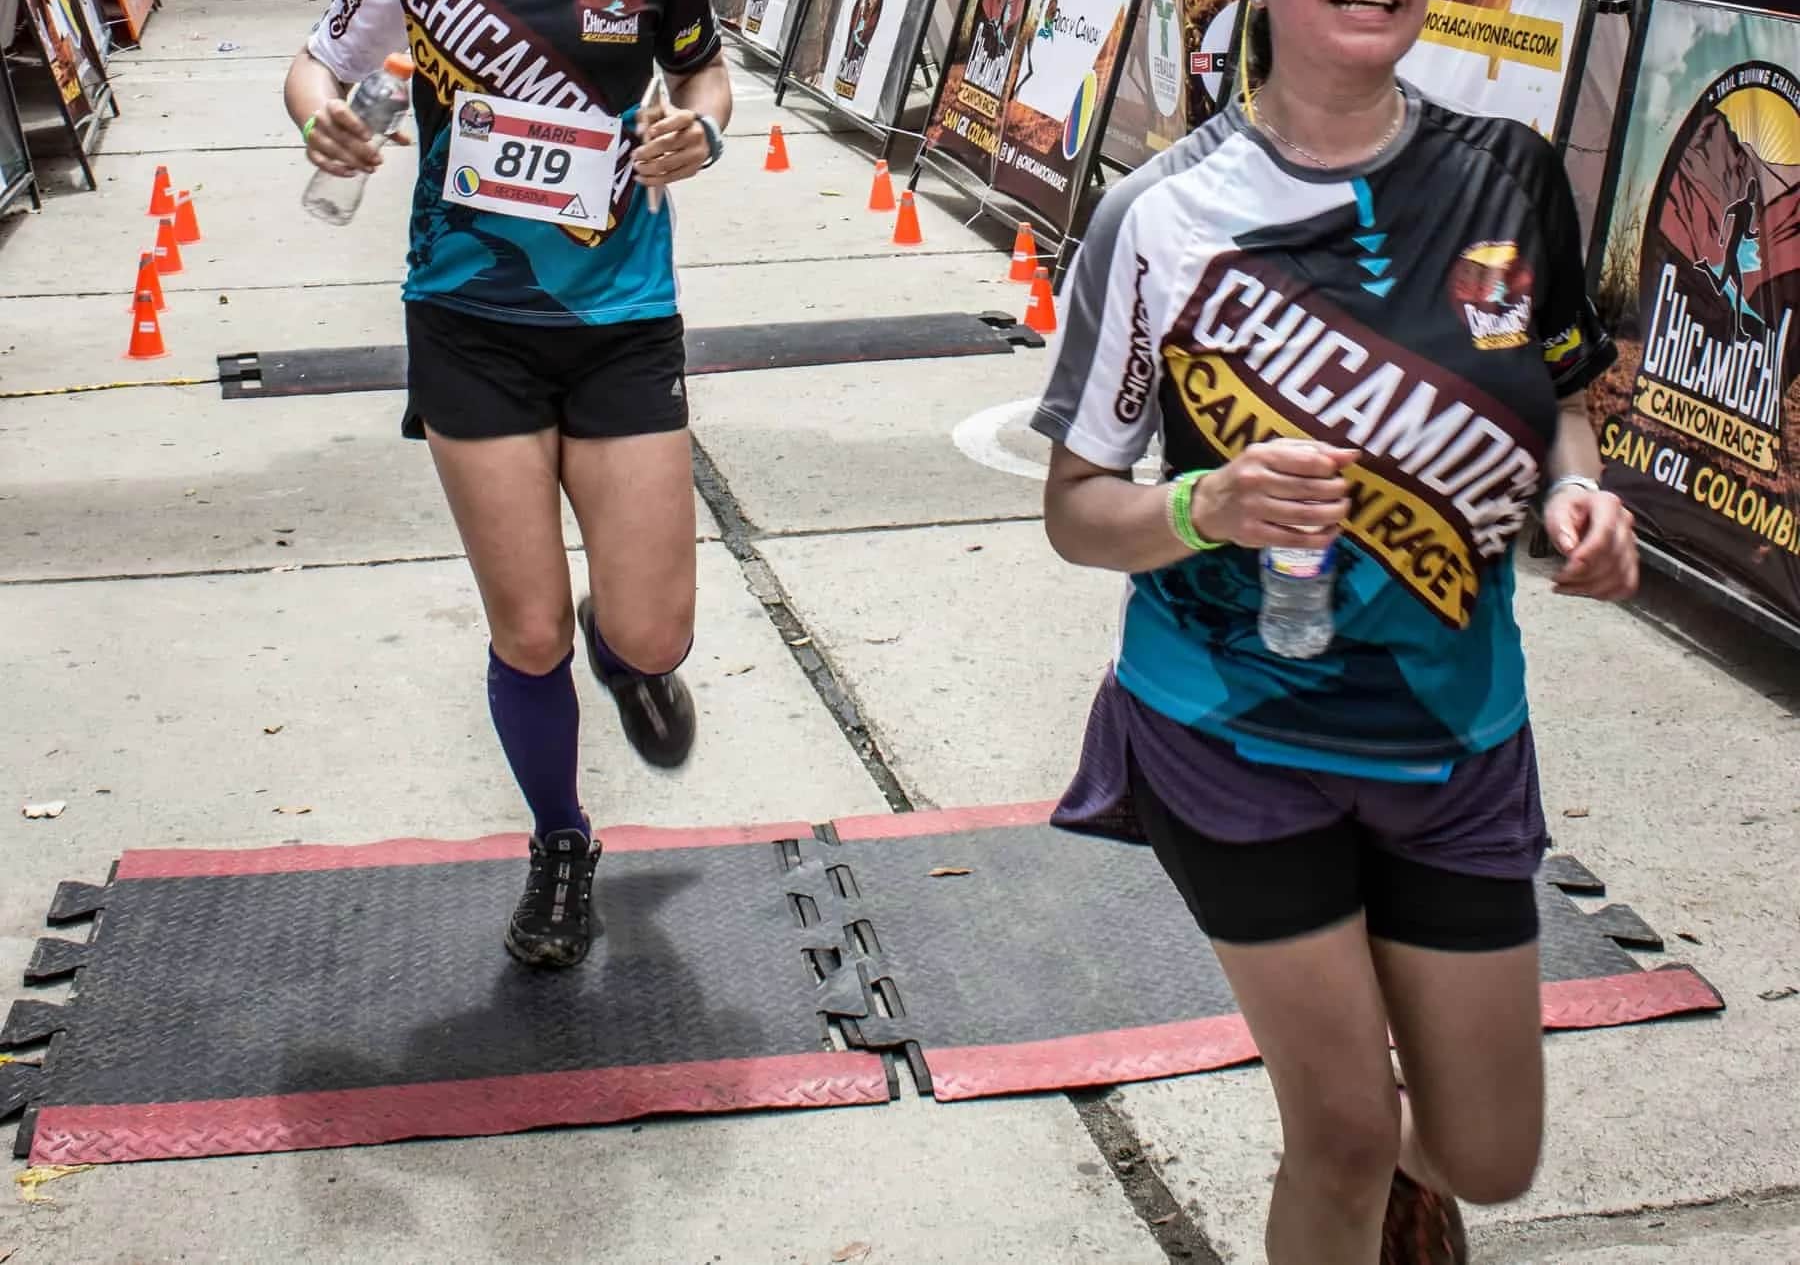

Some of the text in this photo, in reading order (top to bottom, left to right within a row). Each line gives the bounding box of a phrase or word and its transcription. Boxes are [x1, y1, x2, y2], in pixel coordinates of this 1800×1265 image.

[495, 141, 571, 184] 819
[1644, 263, 1793, 430] CHICAMOCHA
[1601, 423, 1656, 474] SAN
[1654, 448, 1689, 495] GIL
[1650, 388, 1765, 463] CANYON RACE
